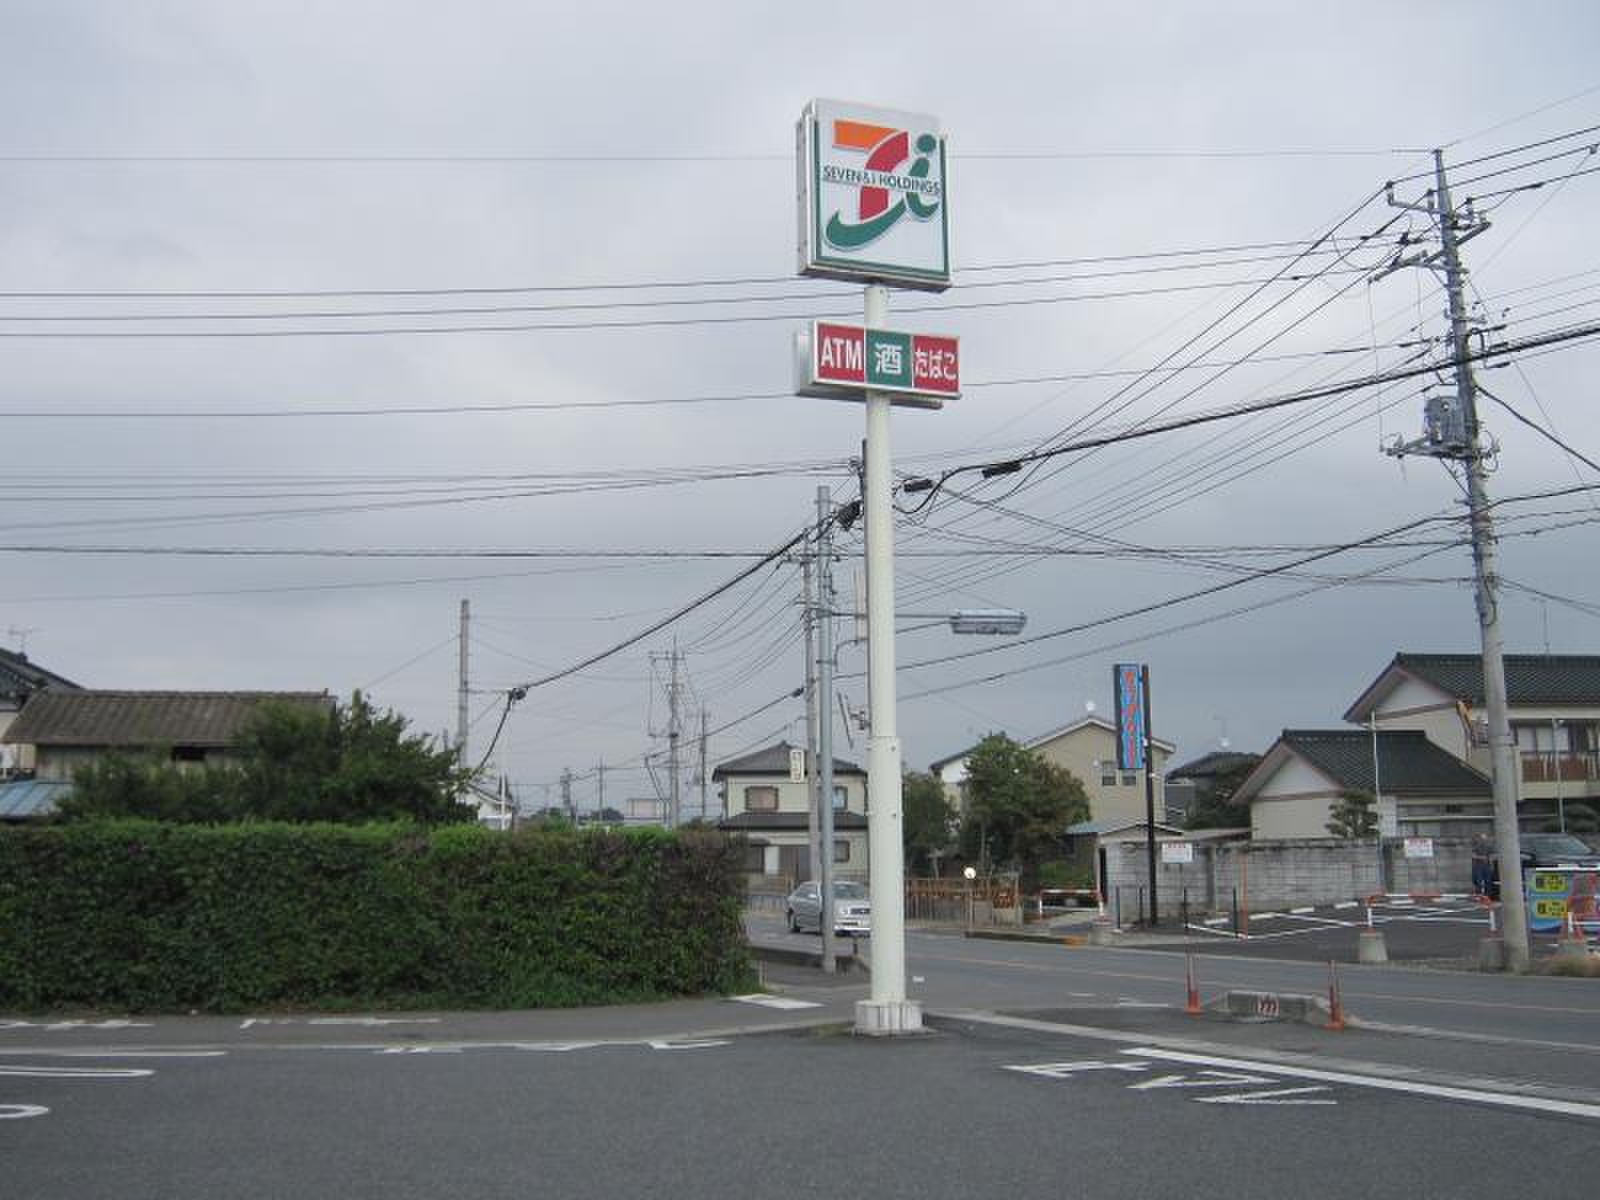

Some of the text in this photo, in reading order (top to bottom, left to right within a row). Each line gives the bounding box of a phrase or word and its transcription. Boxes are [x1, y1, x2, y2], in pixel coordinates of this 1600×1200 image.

[879, 172, 941, 195] HOLDINGS
[820, 336, 863, 371] ATM
[875, 342, 903, 375] 酒
[914, 346, 957, 381] たばこ
